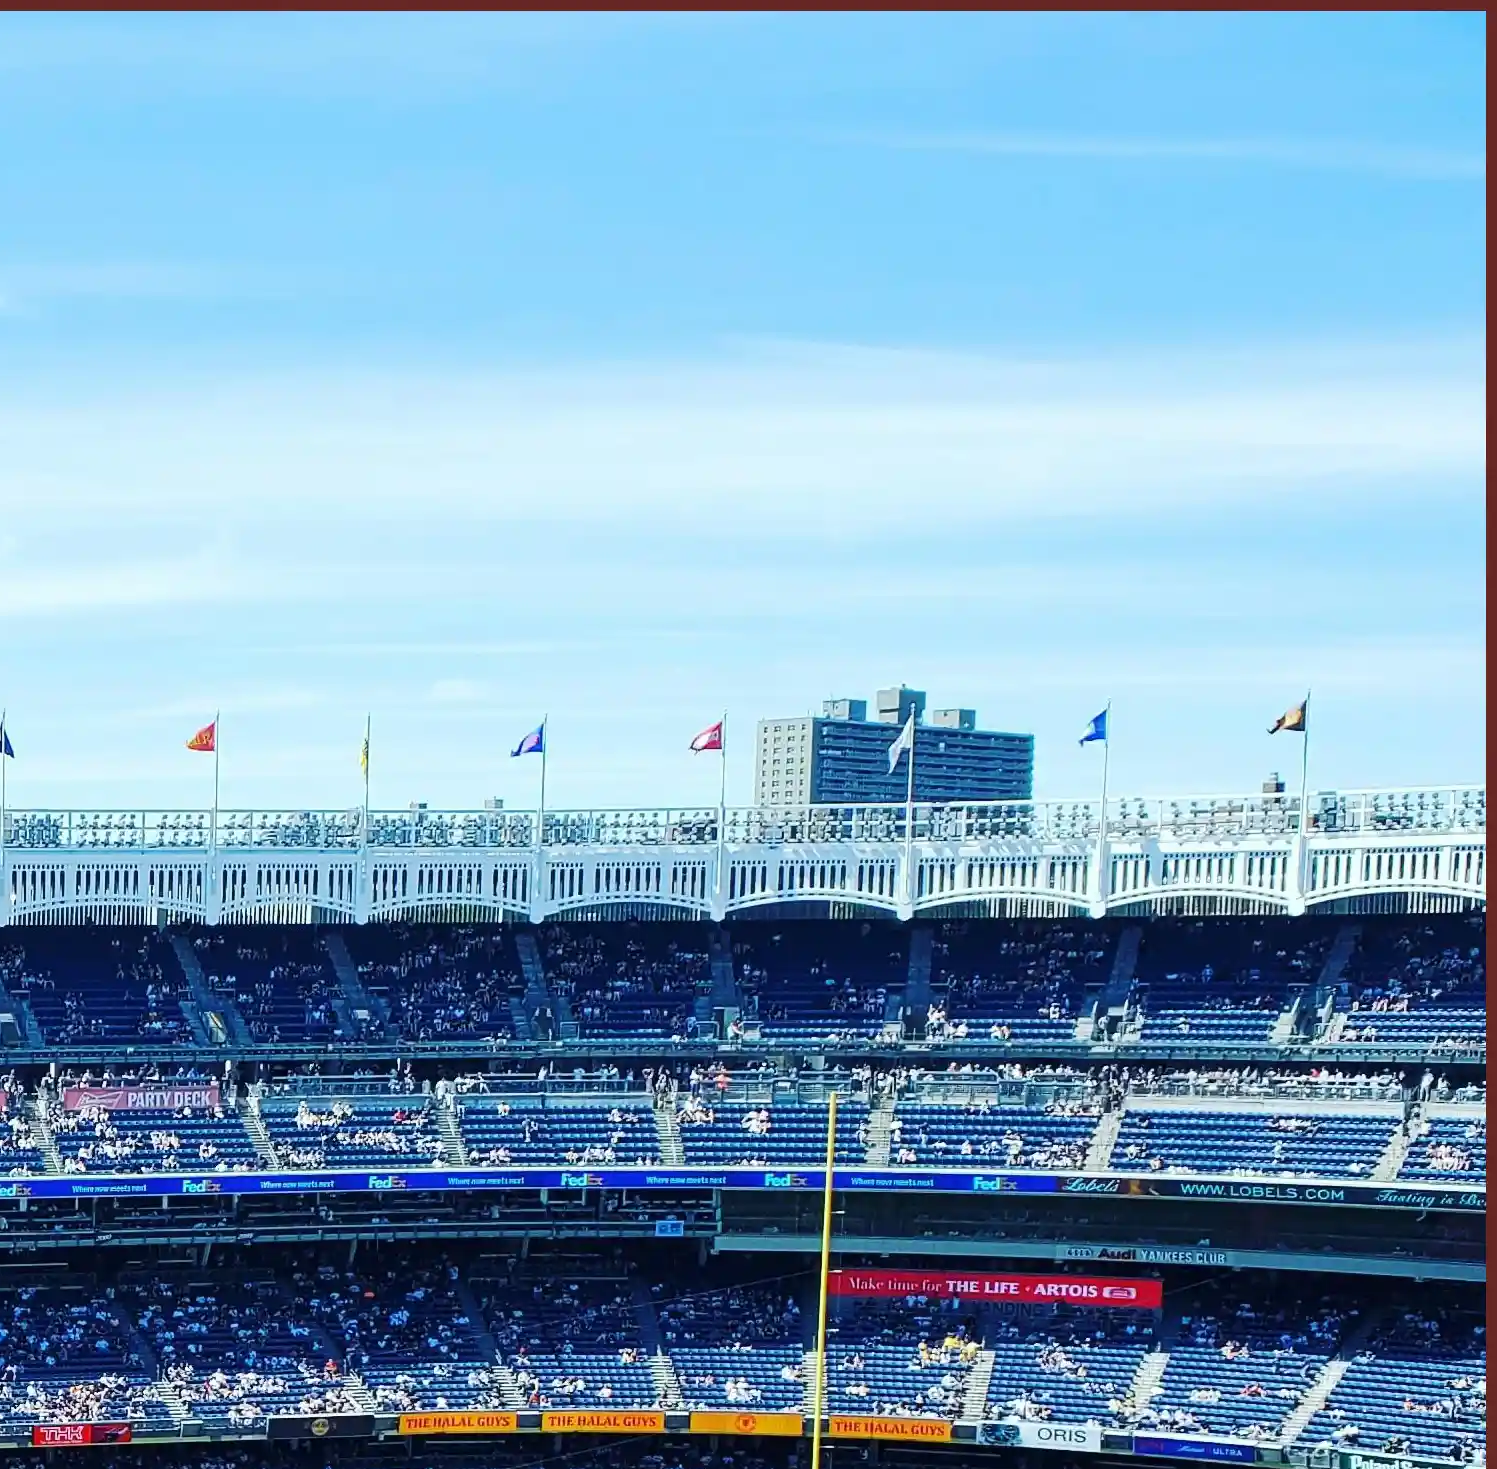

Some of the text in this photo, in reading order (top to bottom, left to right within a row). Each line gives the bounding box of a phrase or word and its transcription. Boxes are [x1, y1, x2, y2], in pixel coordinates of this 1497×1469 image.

[127, 1092, 171, 1108] PARTY
[173, 1091, 211, 1108] DECK
[182, 1180, 221, 1193] FedEx
[368, 1176, 406, 1189] FedEx
[560, 1173, 604, 1186] FedEx
[764, 1174, 808, 1187] FedEx
[973, 1177, 1018, 1191] FedEx
[1062, 1176, 1120, 1193] Lobels
[1180, 1182, 1345, 1201] WWW.LOBELS.COM
[1097, 1249, 1227, 1265] Audi YANKEES CLUB
[849, 1276, 1098, 1298] Make time for THE LIFE ARTOIS
[406, 1416, 511, 1429] THE HALAL GUYS
[548, 1415, 657, 1427] THE HALAL GUYS
[40, 1425, 85, 1440] THK
[835, 1421, 860, 1433] THE
[910, 1424, 945, 1436] GUYS
[1037, 1428, 1086, 1443] ORIS
[1212, 1448, 1243, 1457] ULTRA
